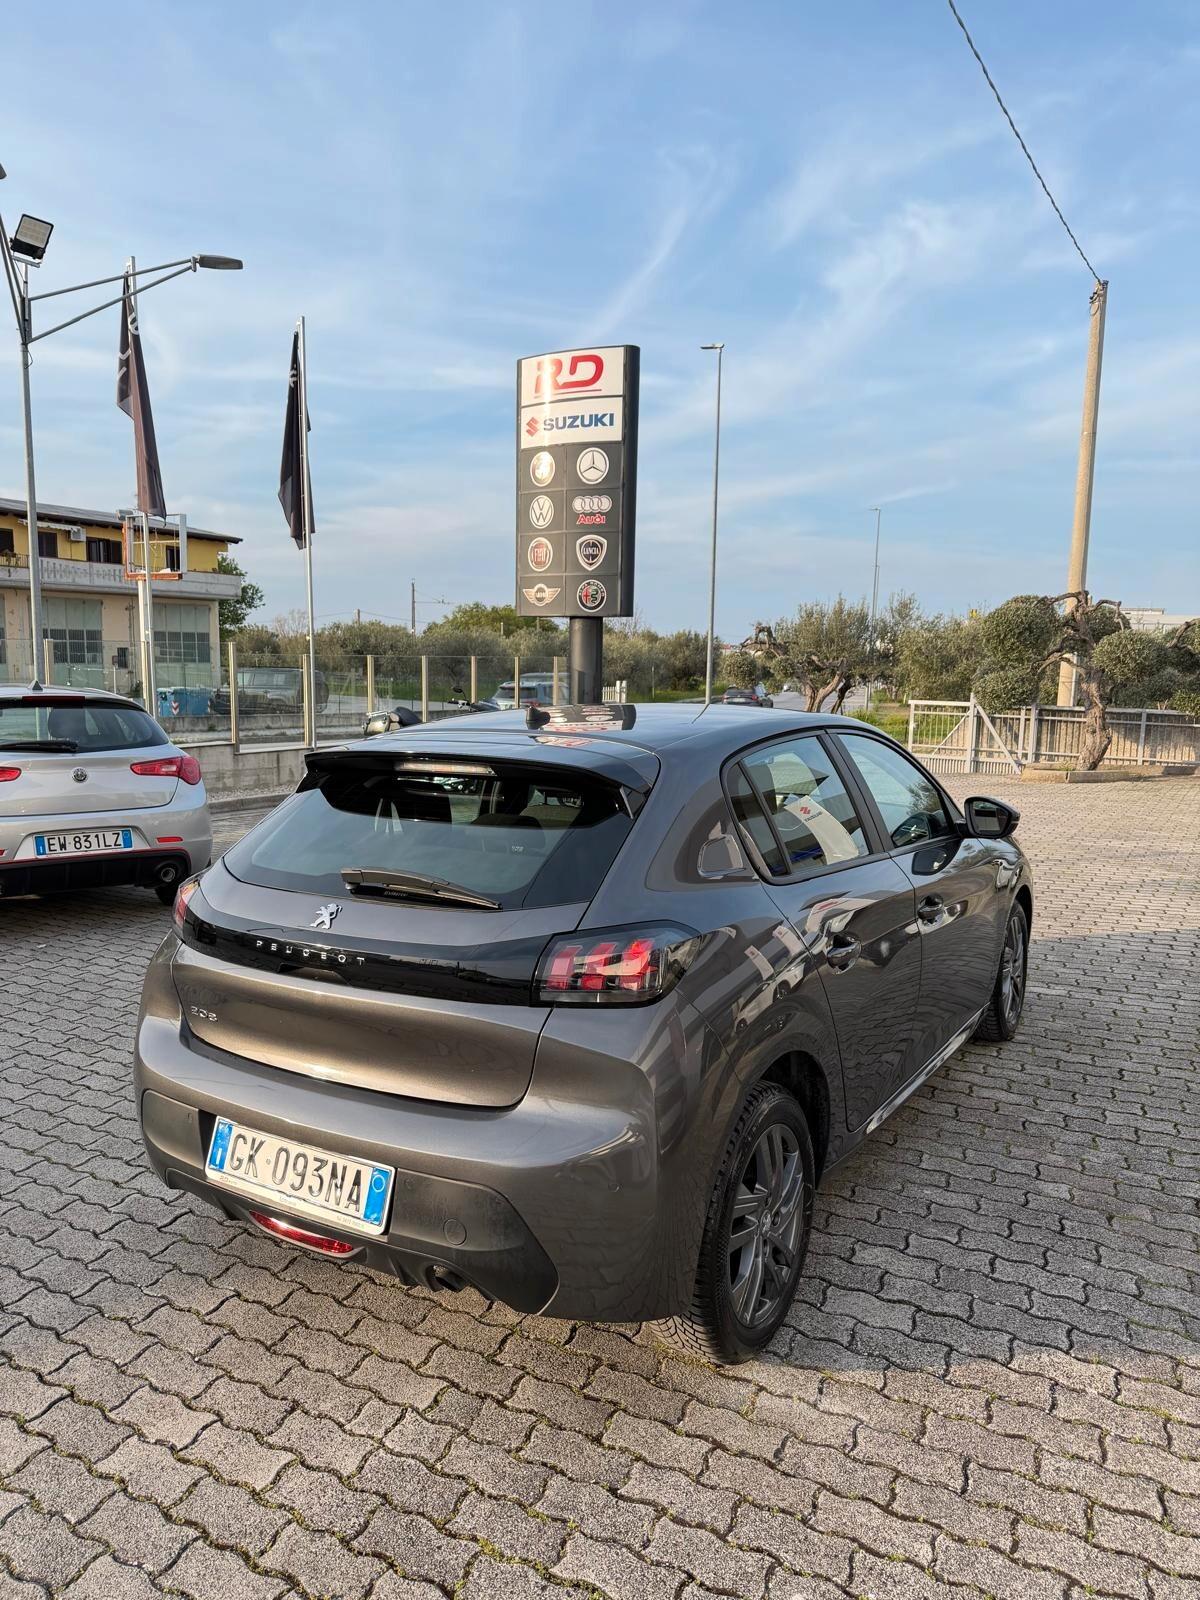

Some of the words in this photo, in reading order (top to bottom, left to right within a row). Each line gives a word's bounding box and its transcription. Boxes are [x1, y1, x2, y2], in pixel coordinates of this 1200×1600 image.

[543, 413, 615, 431] SUZUKI
[576, 513, 606, 525] Audi
[47, 835, 67, 852] EW
[73, 832, 122, 850] 831LZ
[256, 940, 366, 967] PEUGEOT
[190, 1005, 218, 1022] 208
[229, 1133, 266, 1178] GK
[271, 1146, 362, 1213] 093NA
